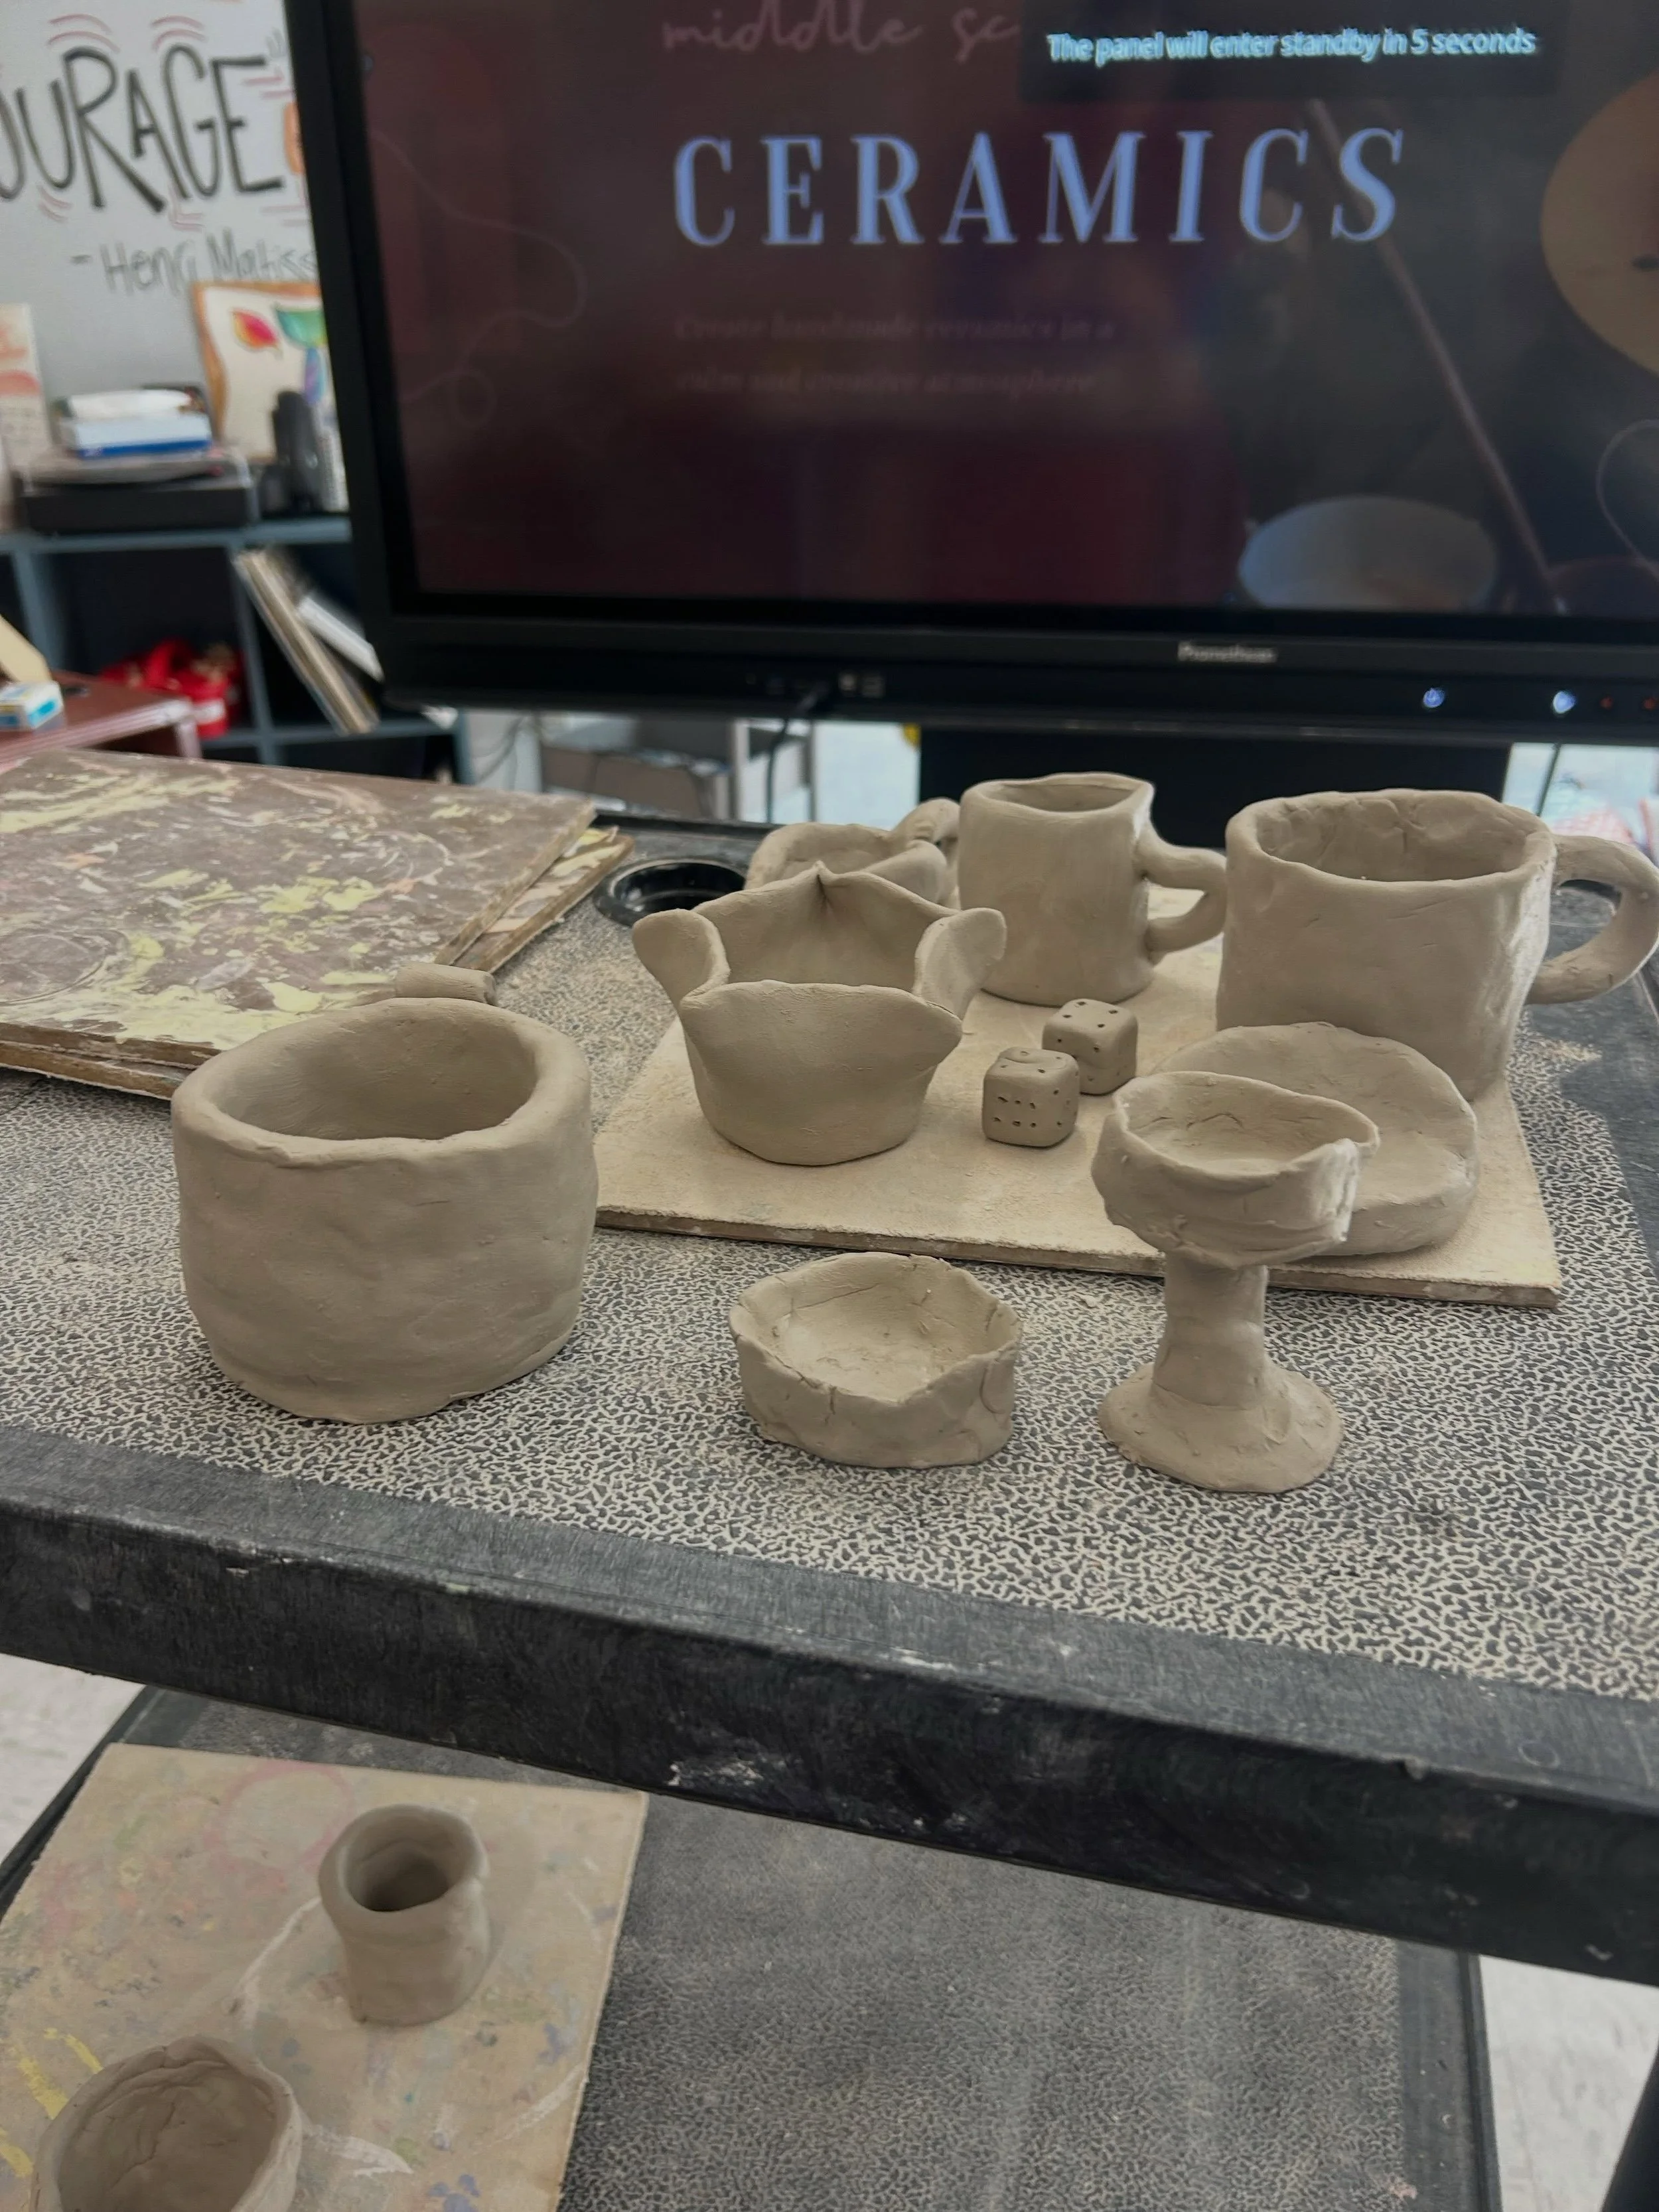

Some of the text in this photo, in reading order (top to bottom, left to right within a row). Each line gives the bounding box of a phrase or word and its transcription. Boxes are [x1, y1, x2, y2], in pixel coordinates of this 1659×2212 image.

[662, 0, 923, 52] middle
[1046, 27, 1537, 68] The panel will enter standby in 5 seconds
[673, 130, 1405, 246] CERAMICS
